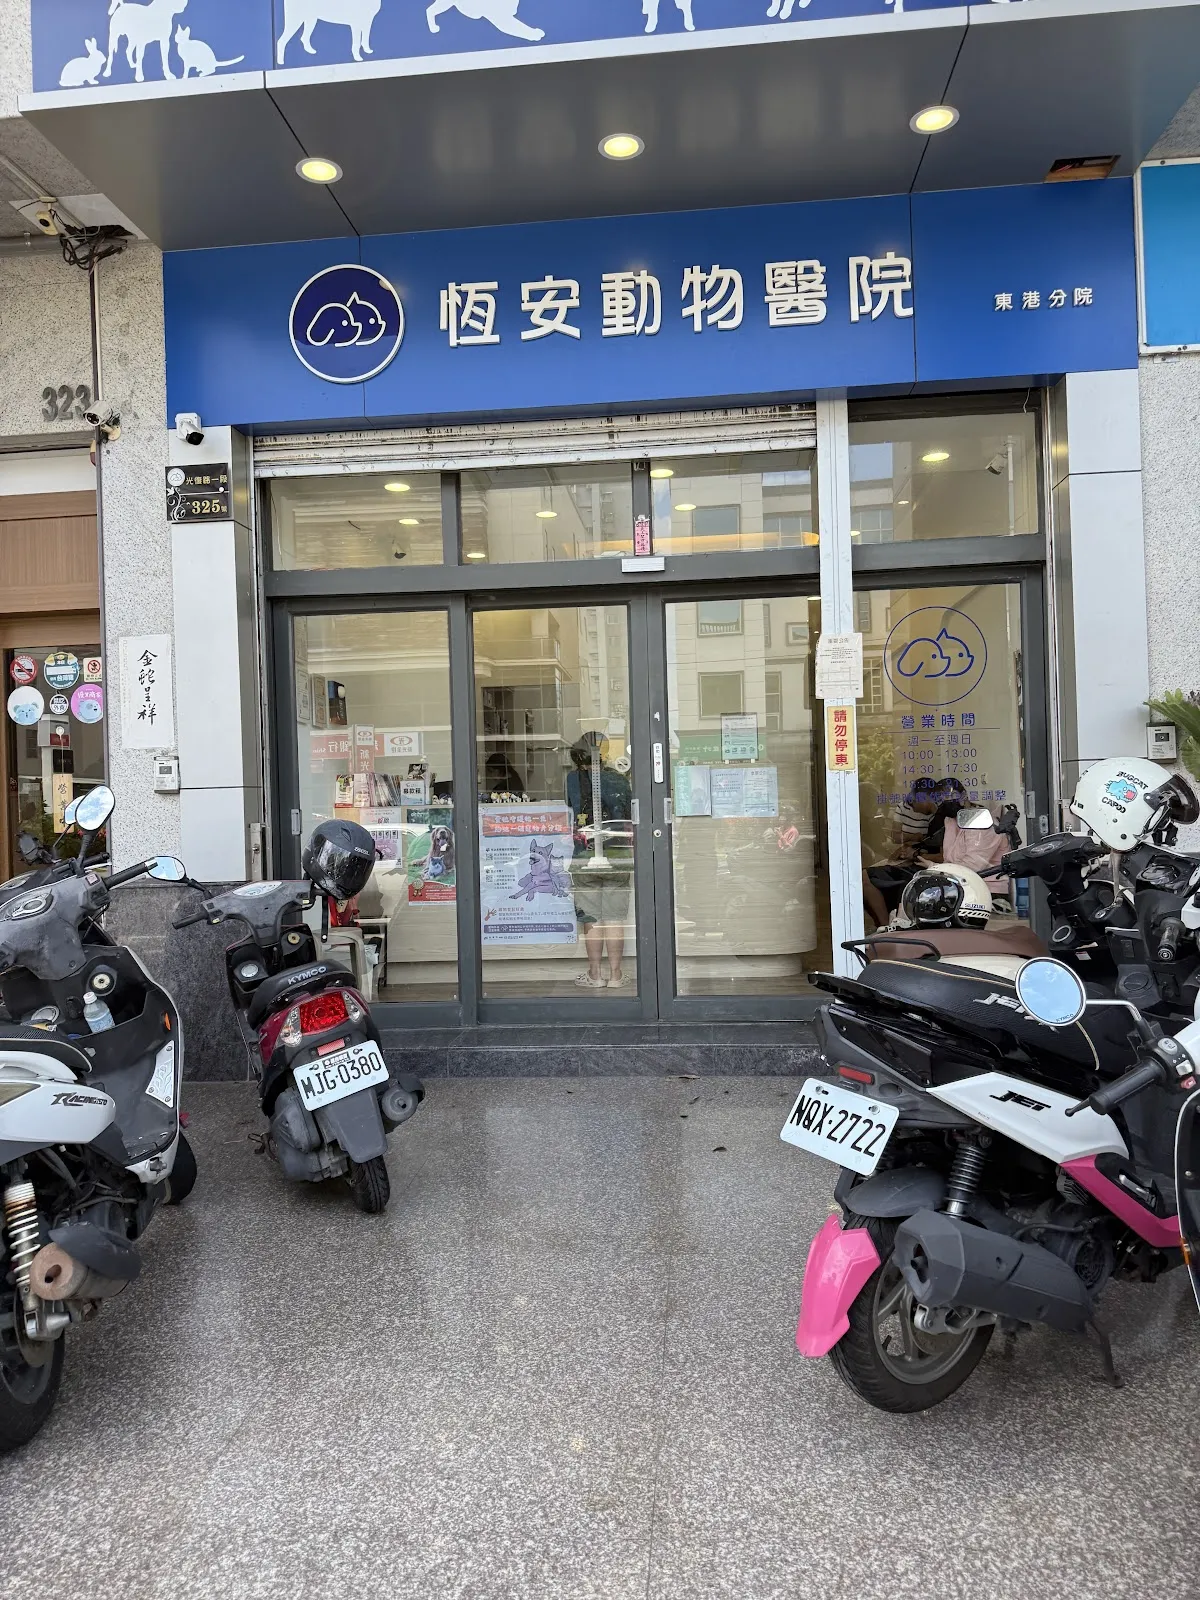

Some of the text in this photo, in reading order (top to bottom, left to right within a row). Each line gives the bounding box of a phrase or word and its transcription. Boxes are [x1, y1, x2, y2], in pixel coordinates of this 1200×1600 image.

[439, 251, 914, 348] 恆安動物醫院
[994, 287, 1093, 312] 東港分院
[901, 713, 975, 730] 營業時間
[834, 710, 848, 766] 請勿停車
[908, 734, 971, 747] 週一至週日
[903, 750, 934, 760] 10:00
[945, 748, 977, 758] 13:00
[903, 764, 934, 775] 14:30
[946, 763, 978, 773] 17:30
[287, 965, 328, 985] KYMCO
[300, 1051, 382, 1100] MJG-0380
[988, 1089, 1052, 1112] JET
[790, 1094, 887, 1158] NQX-2722
